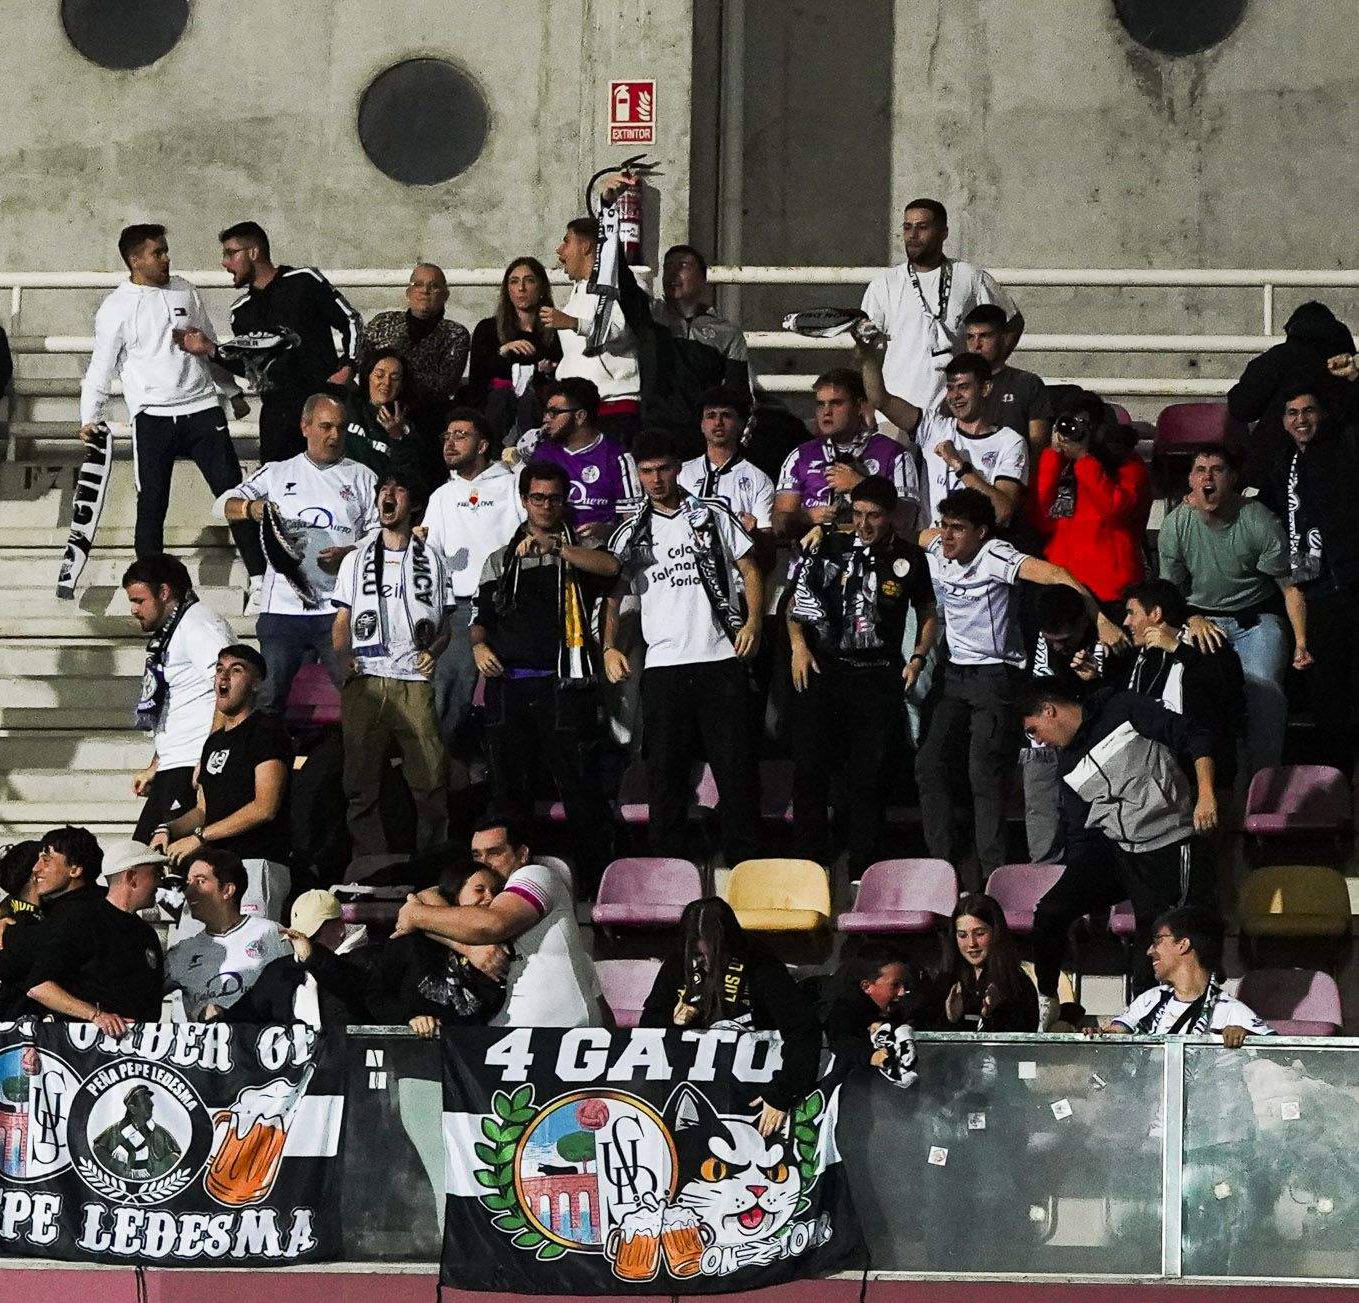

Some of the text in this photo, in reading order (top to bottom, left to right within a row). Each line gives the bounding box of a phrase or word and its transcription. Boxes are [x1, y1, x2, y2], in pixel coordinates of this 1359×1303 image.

[611, 127, 651, 141] EXTINTOR
[668, 543, 694, 559] Caja
[485, 1027, 784, 1083] 4 GATO
[86, 1062, 199, 1112] PEÑA PEPE LEDESMA
[78, 1204, 317, 1257] LEDESMA
[700, 1245, 741, 1276] ON
